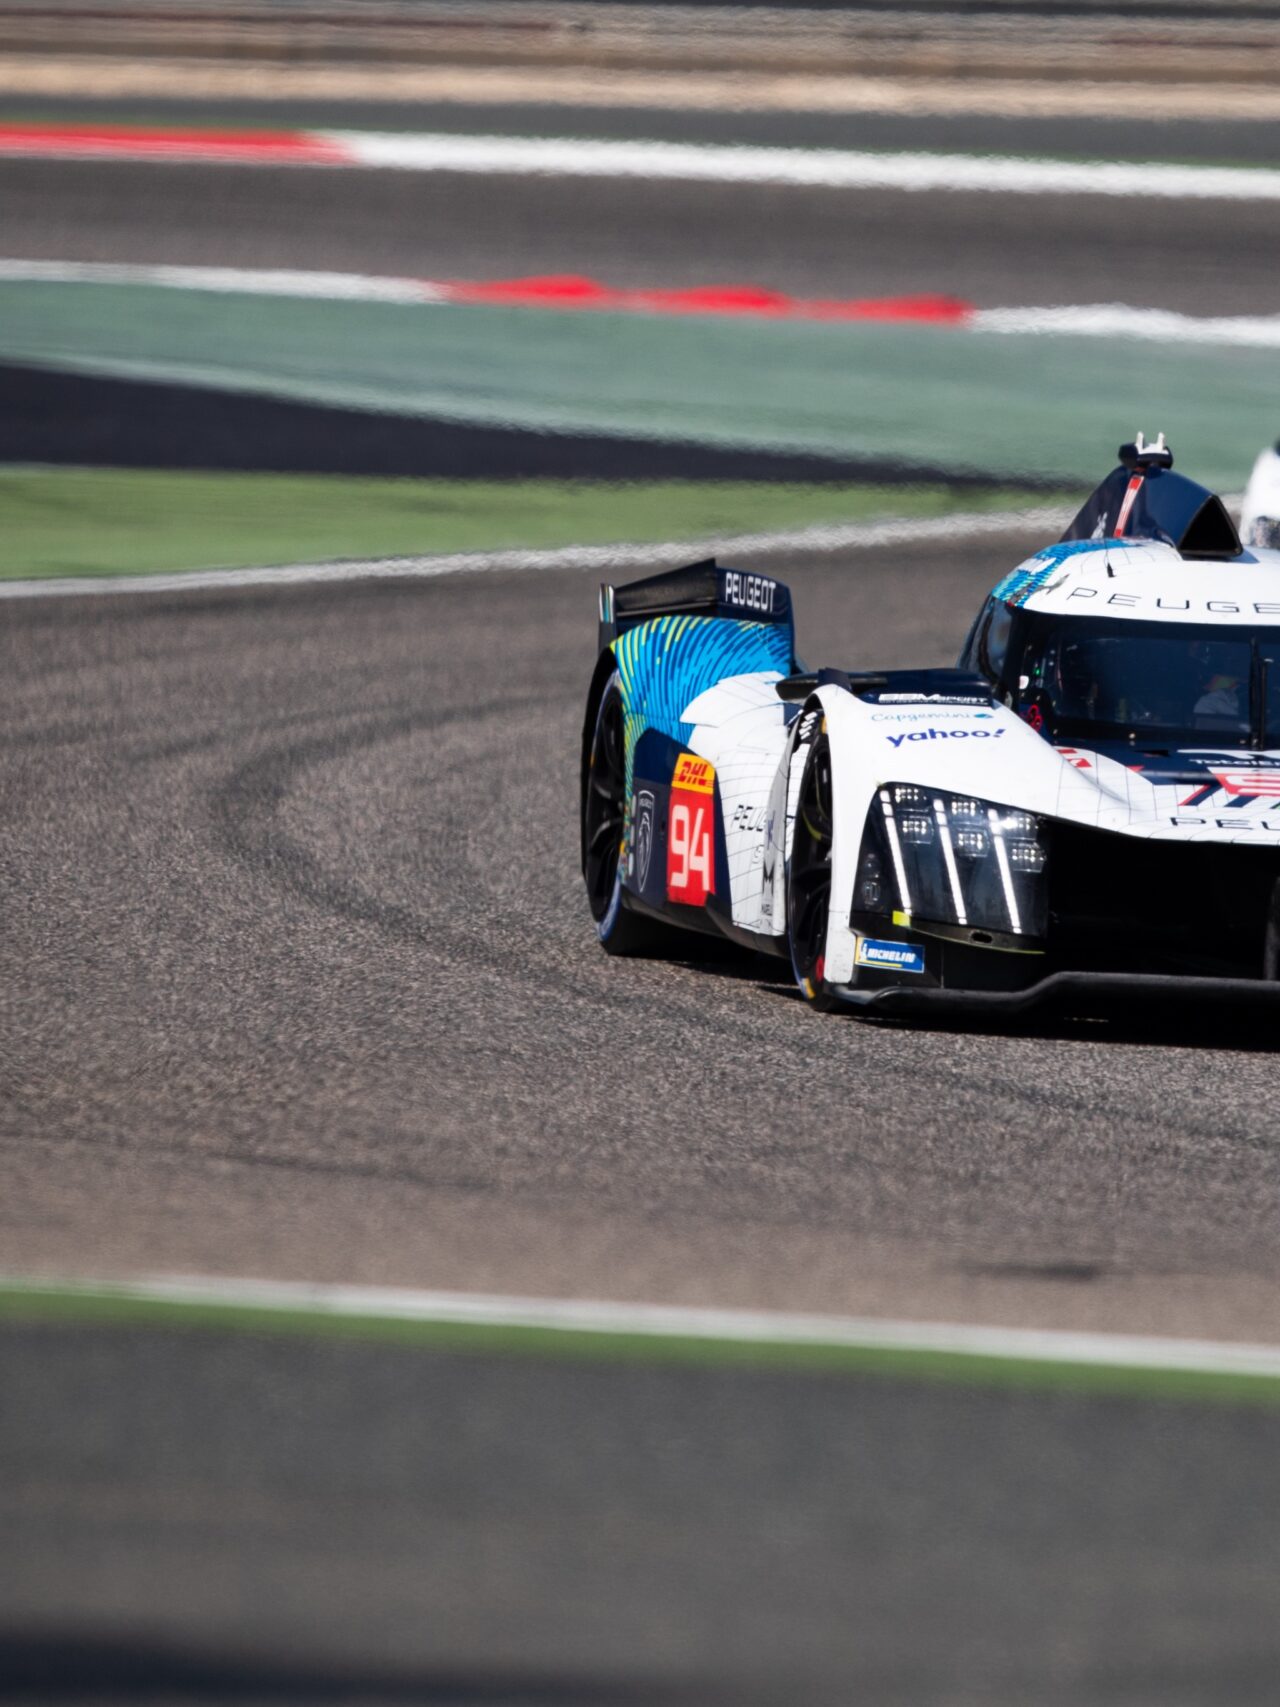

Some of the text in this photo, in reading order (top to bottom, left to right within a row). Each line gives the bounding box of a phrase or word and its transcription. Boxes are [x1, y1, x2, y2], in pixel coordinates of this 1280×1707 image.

[725, 571, 777, 613] PEUGEOT
[886, 728, 1006, 748] yahoo!
[678, 760, 709, 786] DHL
[671, 804, 711, 892] 94
[866, 948, 917, 964] MICHELIN
